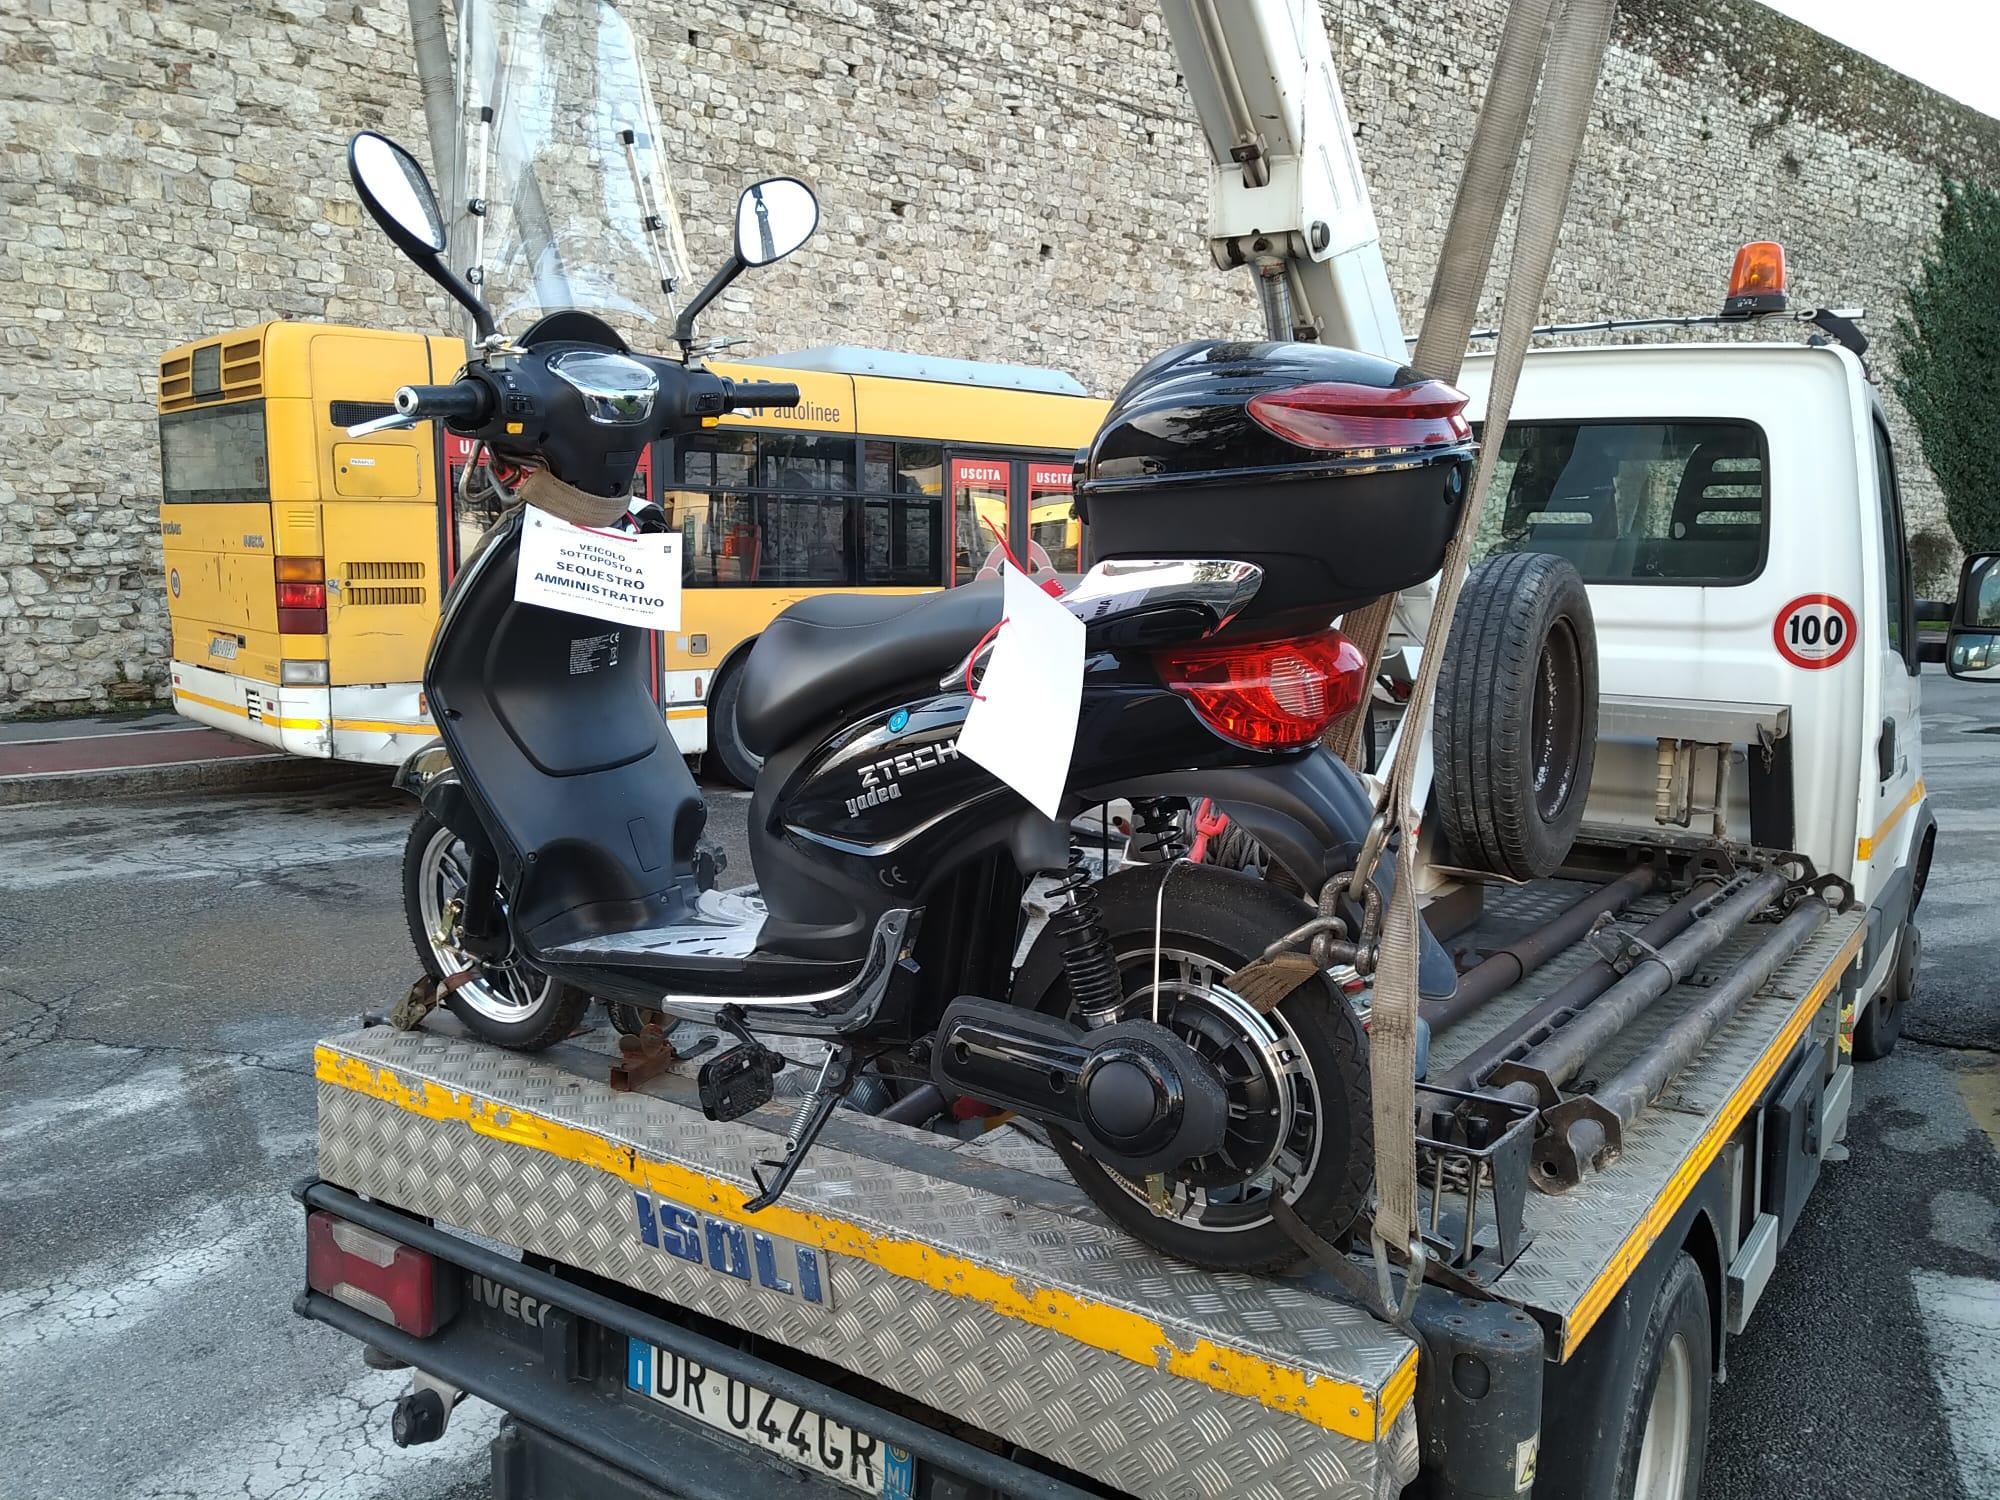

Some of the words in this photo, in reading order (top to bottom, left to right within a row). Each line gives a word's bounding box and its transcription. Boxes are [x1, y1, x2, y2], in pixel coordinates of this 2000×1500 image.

[774, 401, 840, 423] autolinee
[960, 467, 1001, 481] USCITA
[1036, 472, 1072, 484] USCITA
[559, 548, 632, 573] SOTTOPOSTO
[579, 543, 626, 562] VEICOLO
[534, 572, 665, 608] AMMINISTRATIVO
[556, 561, 645, 590] SEQUESTRO
[1789, 615, 1843, 646] 100
[857, 739, 959, 788] ZTECH
[845, 783, 902, 818] yadea
[634, 1191, 824, 1305] ISOLI
